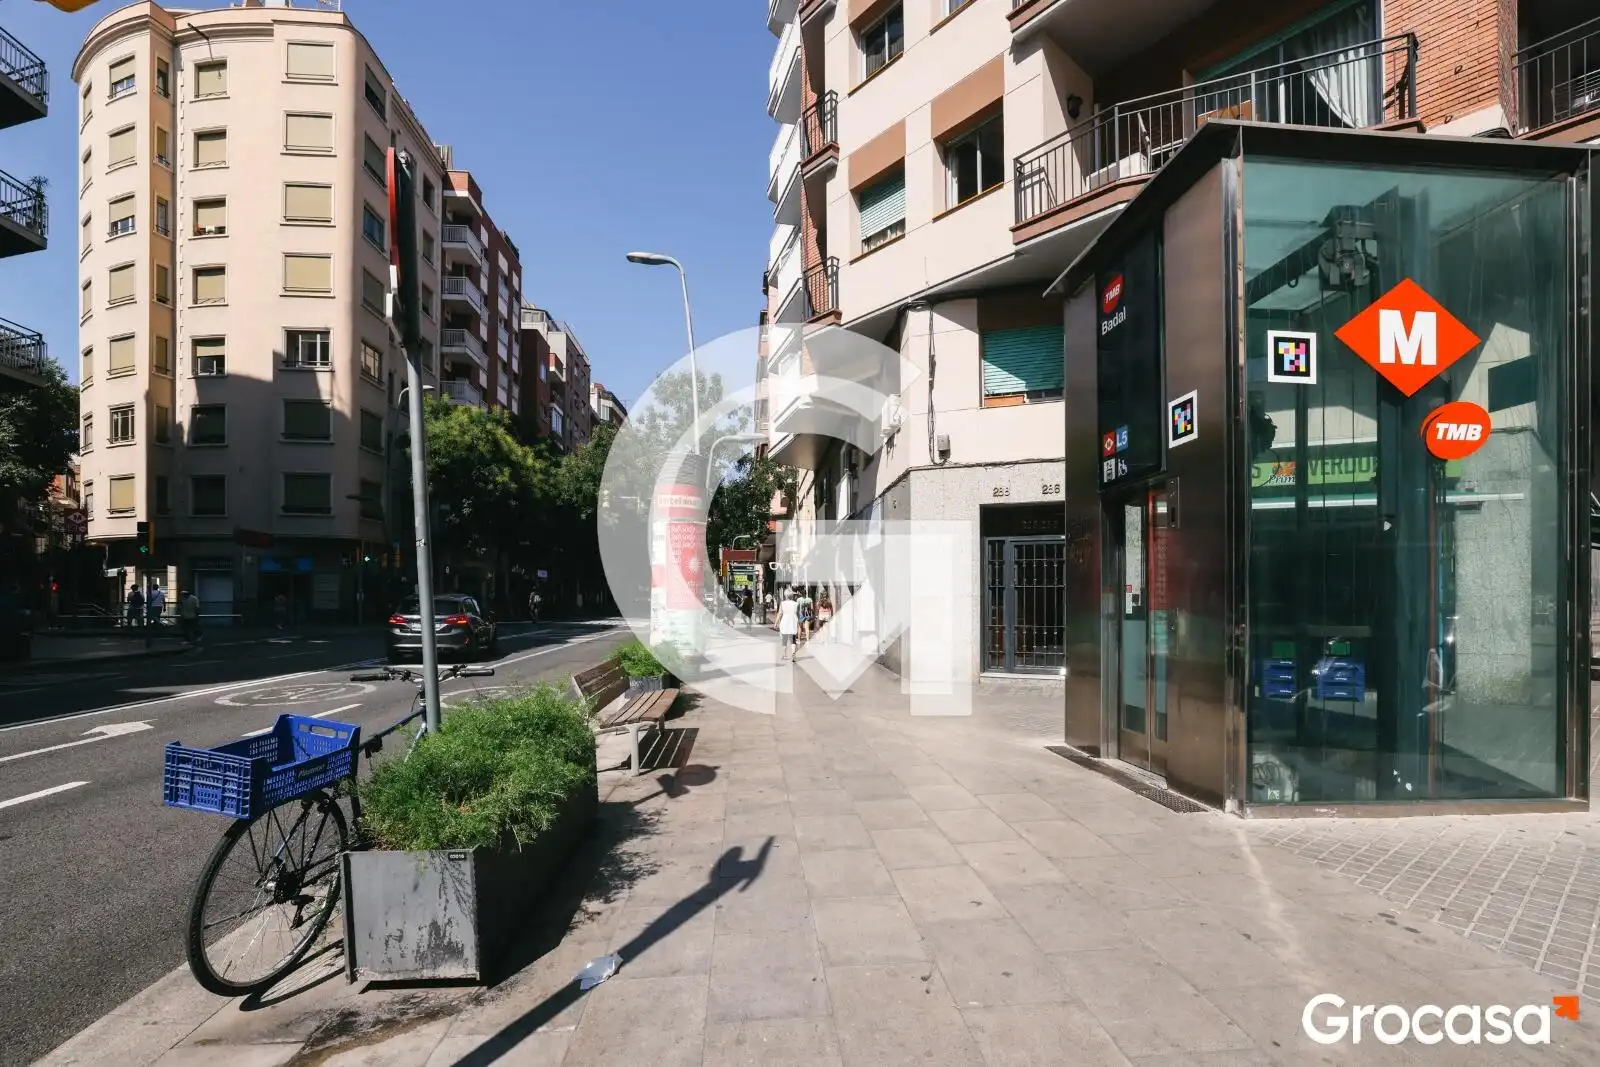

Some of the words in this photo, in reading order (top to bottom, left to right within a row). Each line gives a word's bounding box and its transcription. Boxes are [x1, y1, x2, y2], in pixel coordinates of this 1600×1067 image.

[1105, 284, 1120, 304] TMB
[1102, 306, 1126, 336] Badal
[1379, 309, 1437, 366] M
[1116, 430, 1128, 448] L5
[1436, 423, 1483, 441] TMB
